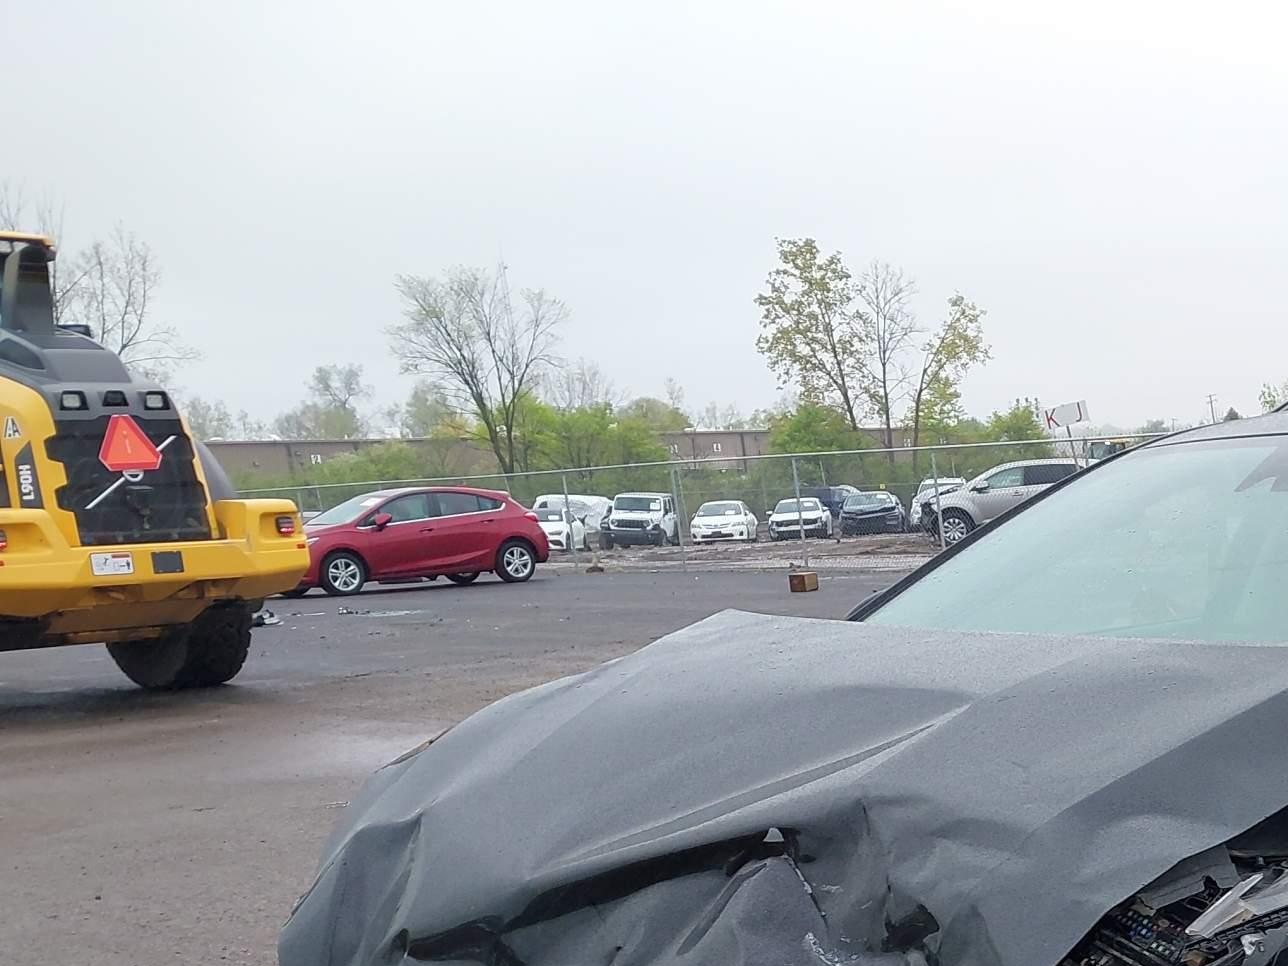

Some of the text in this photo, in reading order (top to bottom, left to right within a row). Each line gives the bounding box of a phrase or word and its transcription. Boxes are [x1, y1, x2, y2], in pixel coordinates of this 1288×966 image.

[1044, 401, 1083, 430] K J
[18, 464, 36, 501] L90H
